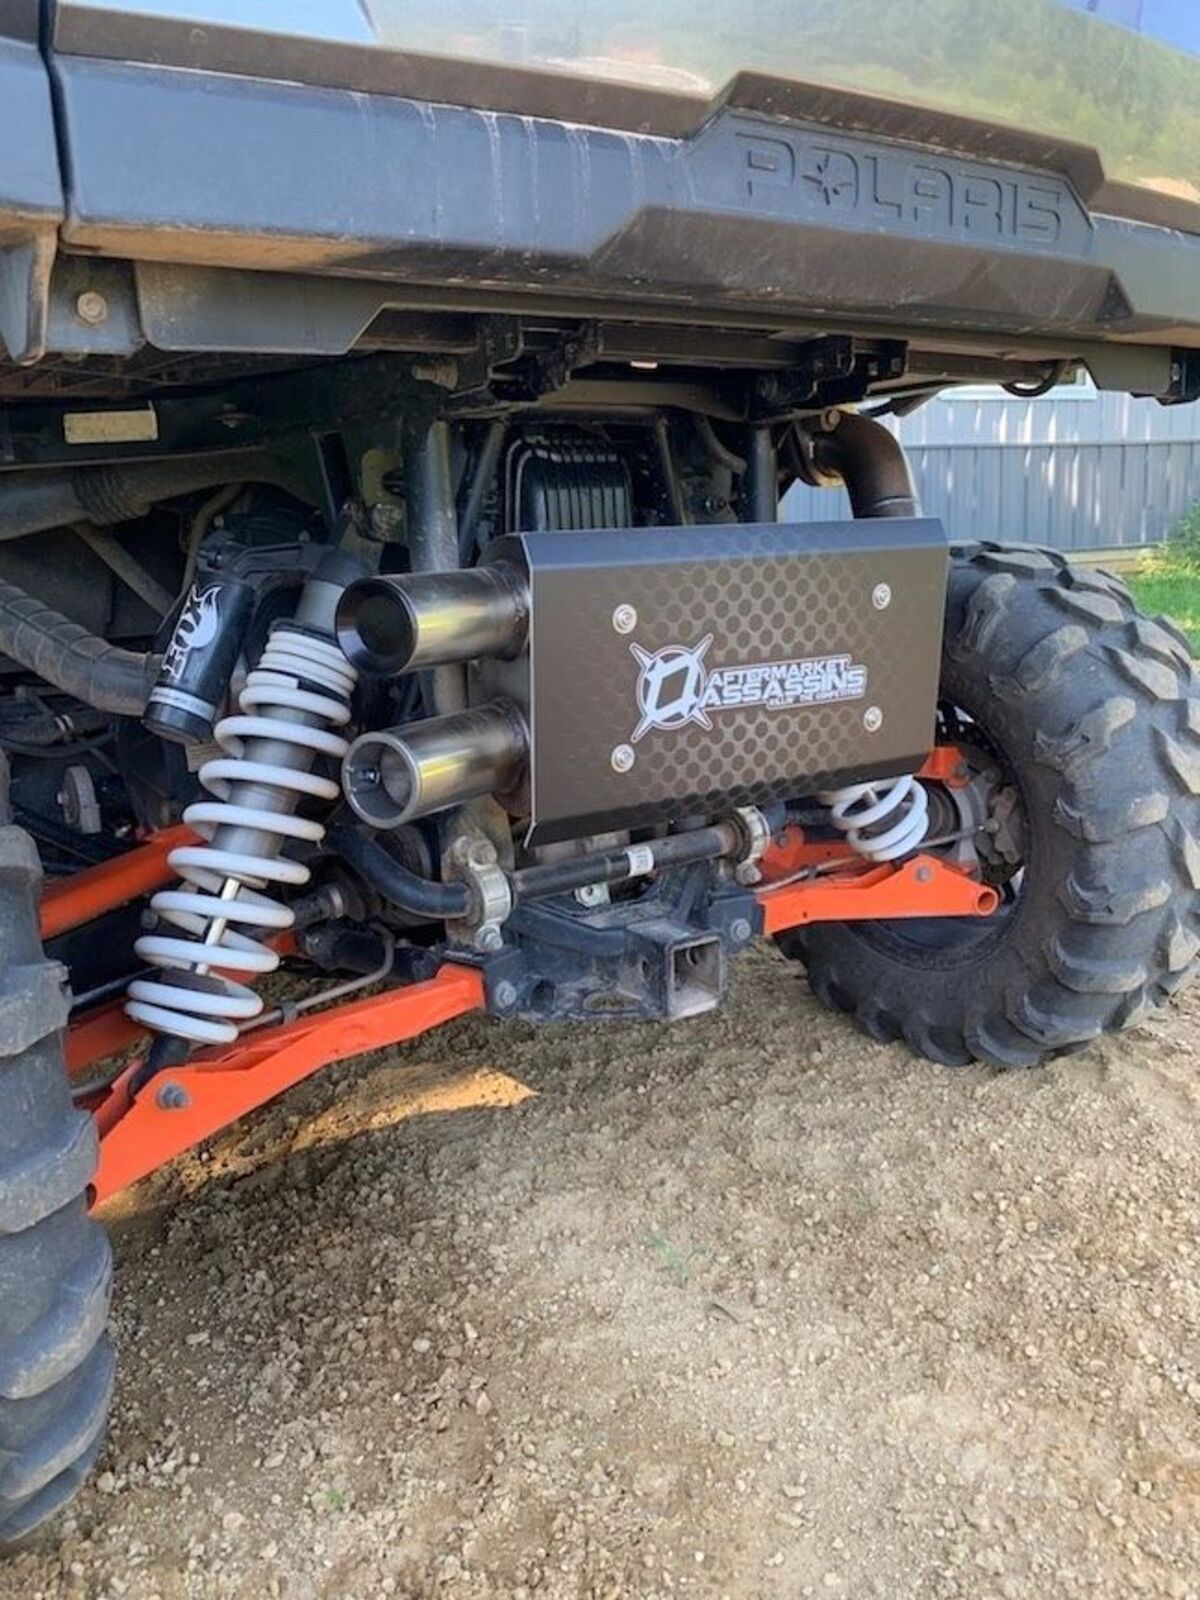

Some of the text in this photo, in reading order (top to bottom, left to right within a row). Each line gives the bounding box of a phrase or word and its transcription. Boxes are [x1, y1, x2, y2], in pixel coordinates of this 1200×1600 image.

[735, 131, 1064, 242] POLARIS
[161, 583, 222, 683] FOX
[700, 669, 866, 706] ASSASSINS
[708, 658, 849, 688] AFTERMARKET
